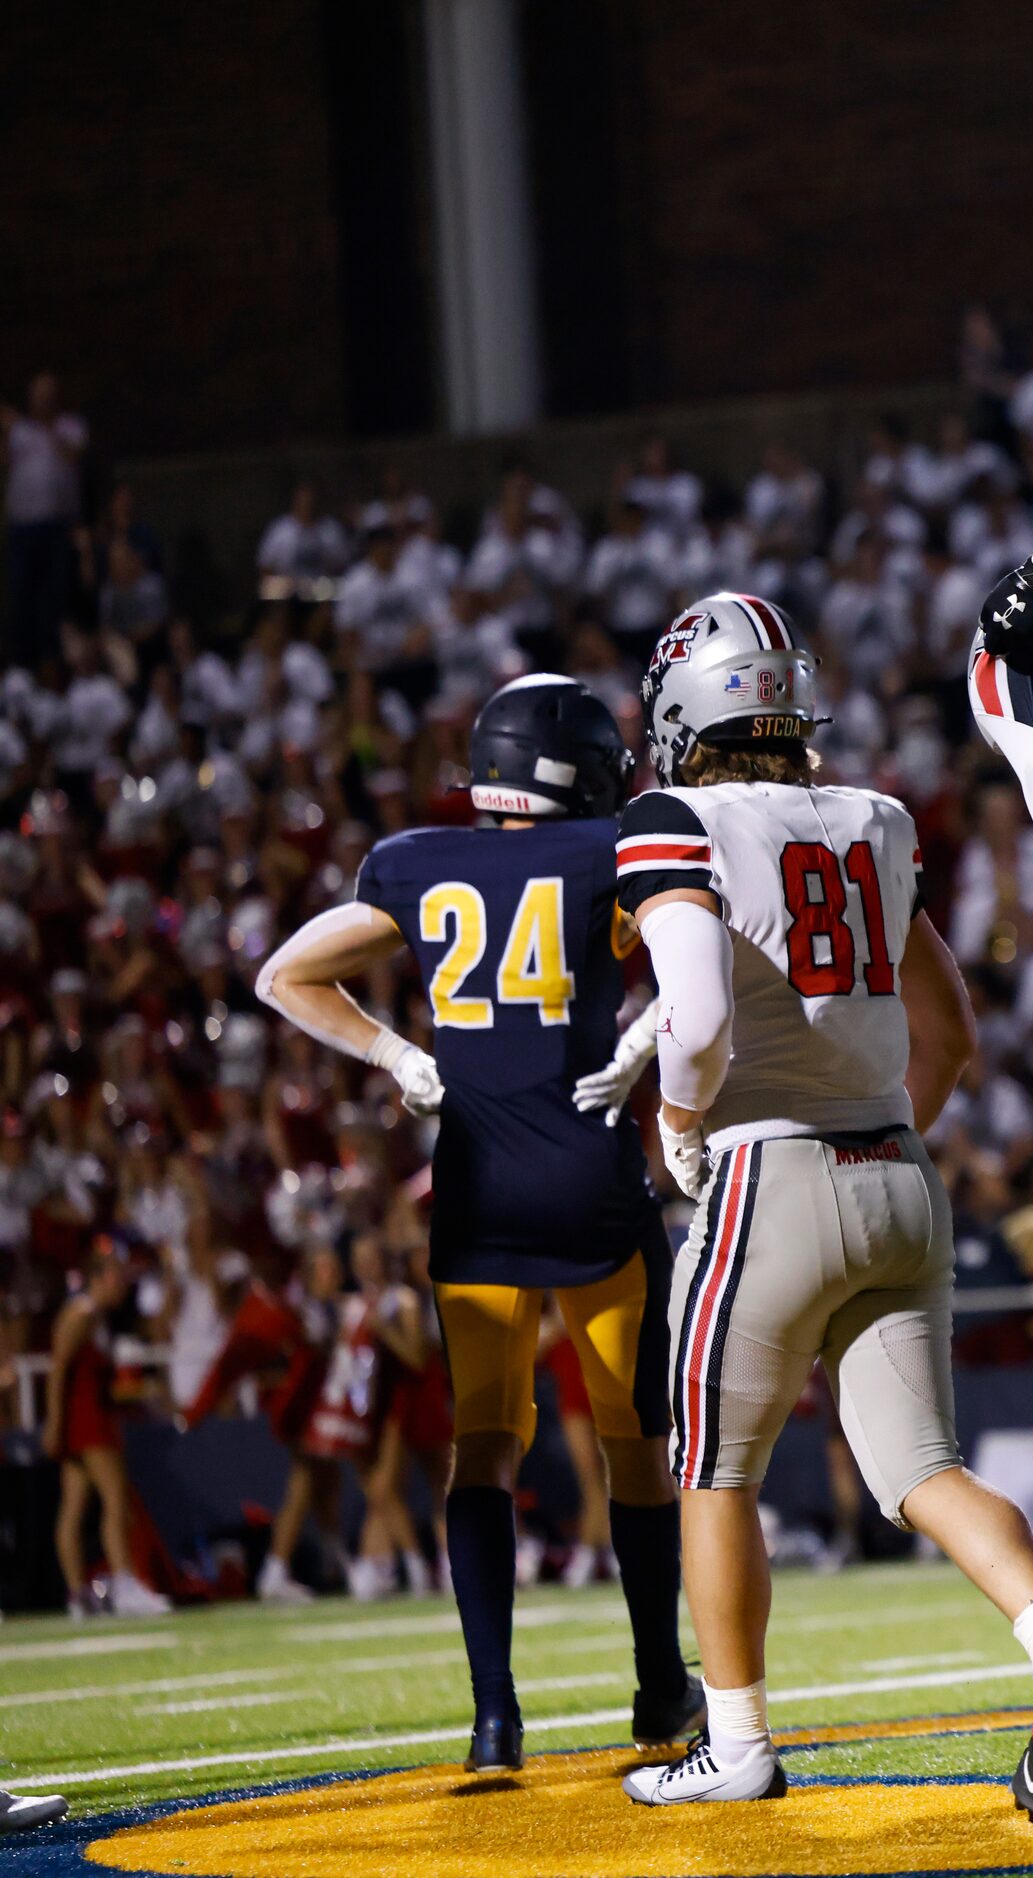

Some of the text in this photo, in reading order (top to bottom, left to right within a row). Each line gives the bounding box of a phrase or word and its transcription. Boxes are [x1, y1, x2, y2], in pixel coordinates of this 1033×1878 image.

[656, 629, 697, 650] rcus
[756, 668, 795, 704] 81
[779, 840, 897, 998] 81
[419, 876, 577, 1030] 24
[835, 1140, 903, 1166] MARCUS
